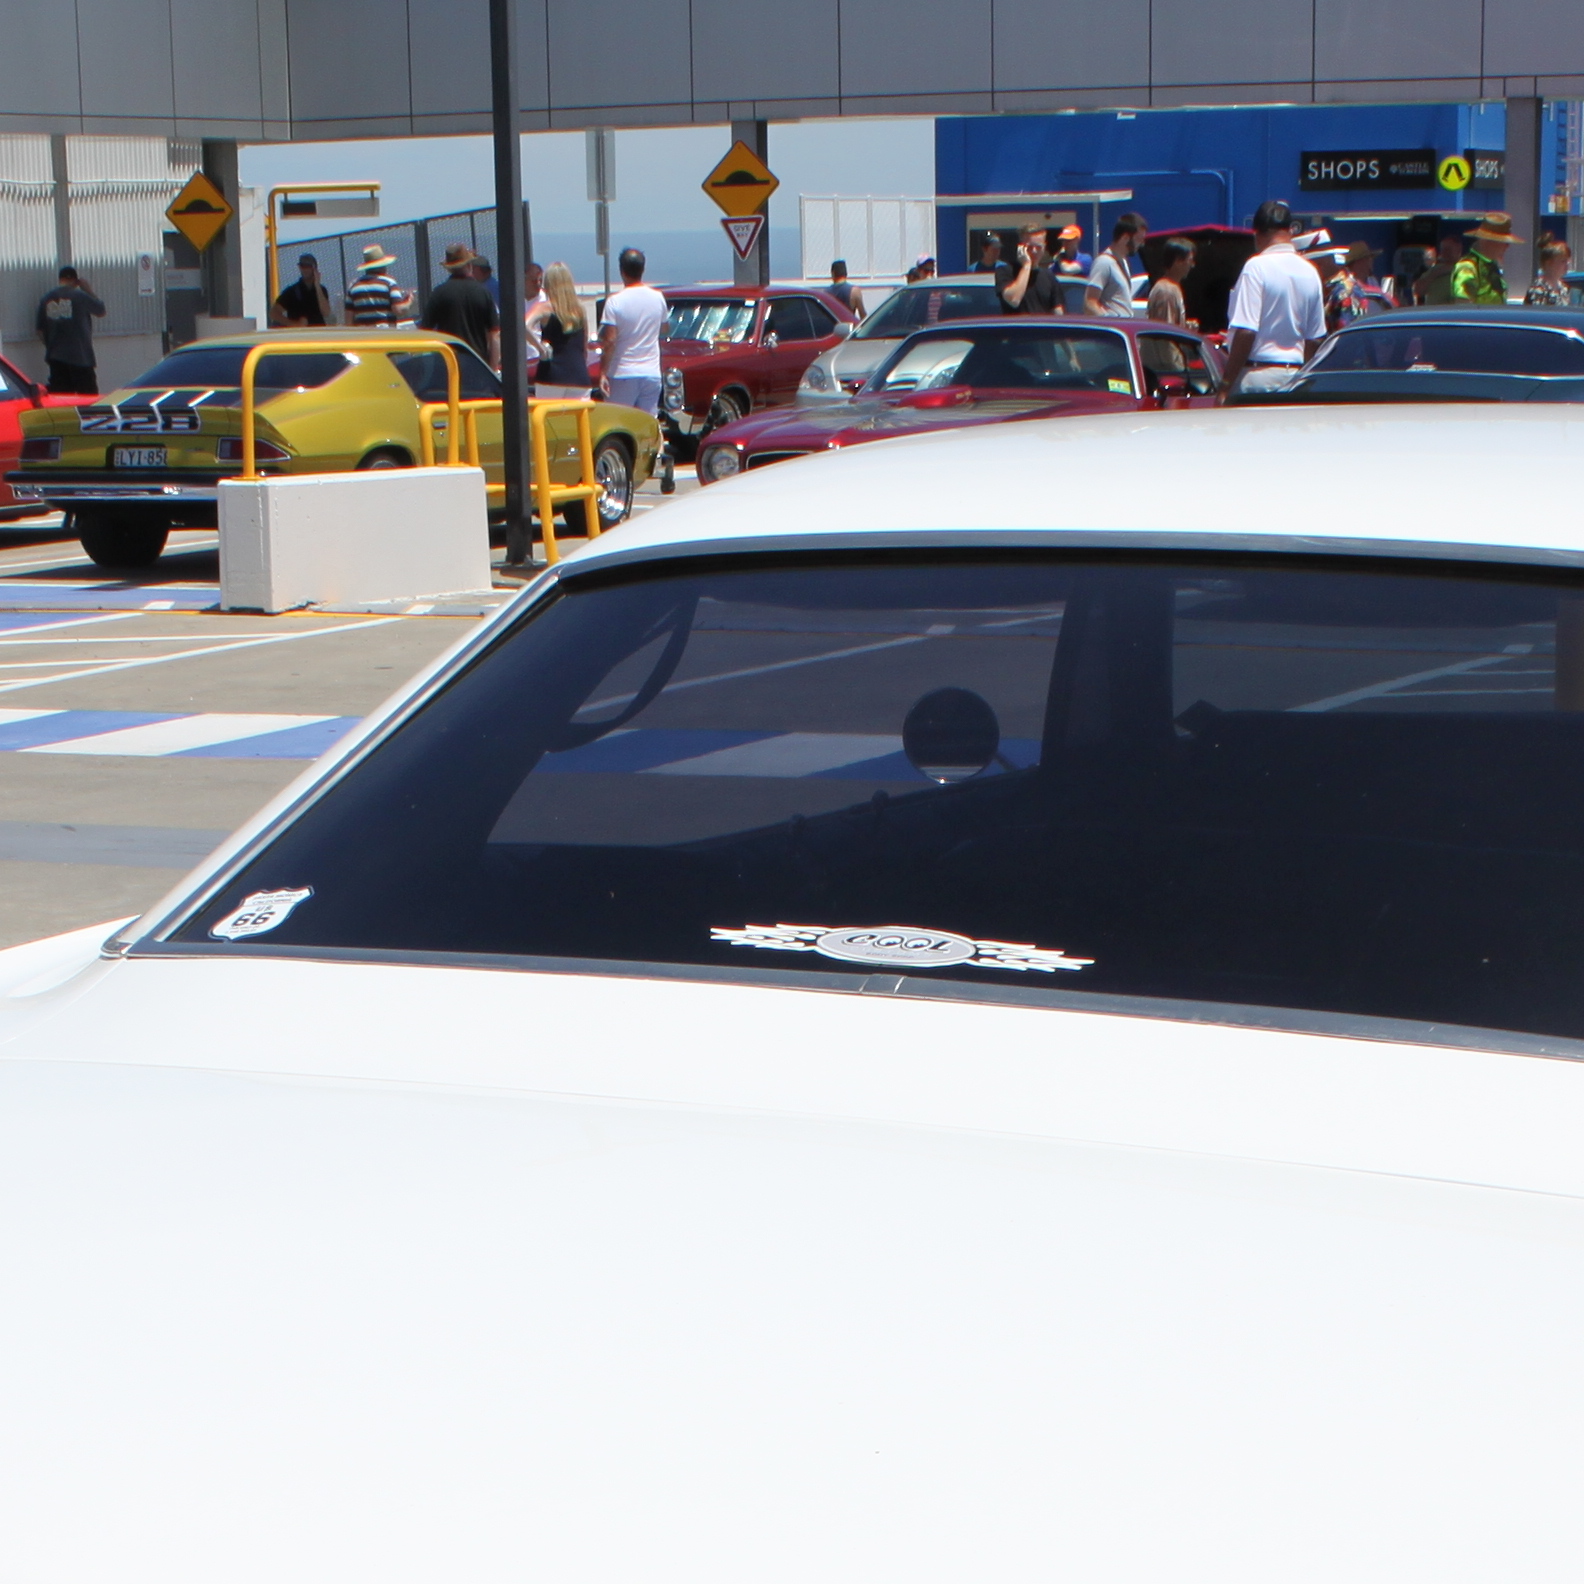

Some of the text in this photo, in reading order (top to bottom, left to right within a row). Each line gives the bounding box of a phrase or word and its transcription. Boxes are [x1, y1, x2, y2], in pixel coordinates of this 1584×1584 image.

[1307, 159, 1380, 180] SHOPS
[81, 414, 201, 431] Z28
[231, 911, 277, 927] 66
[844, 934, 953, 954] COOL
